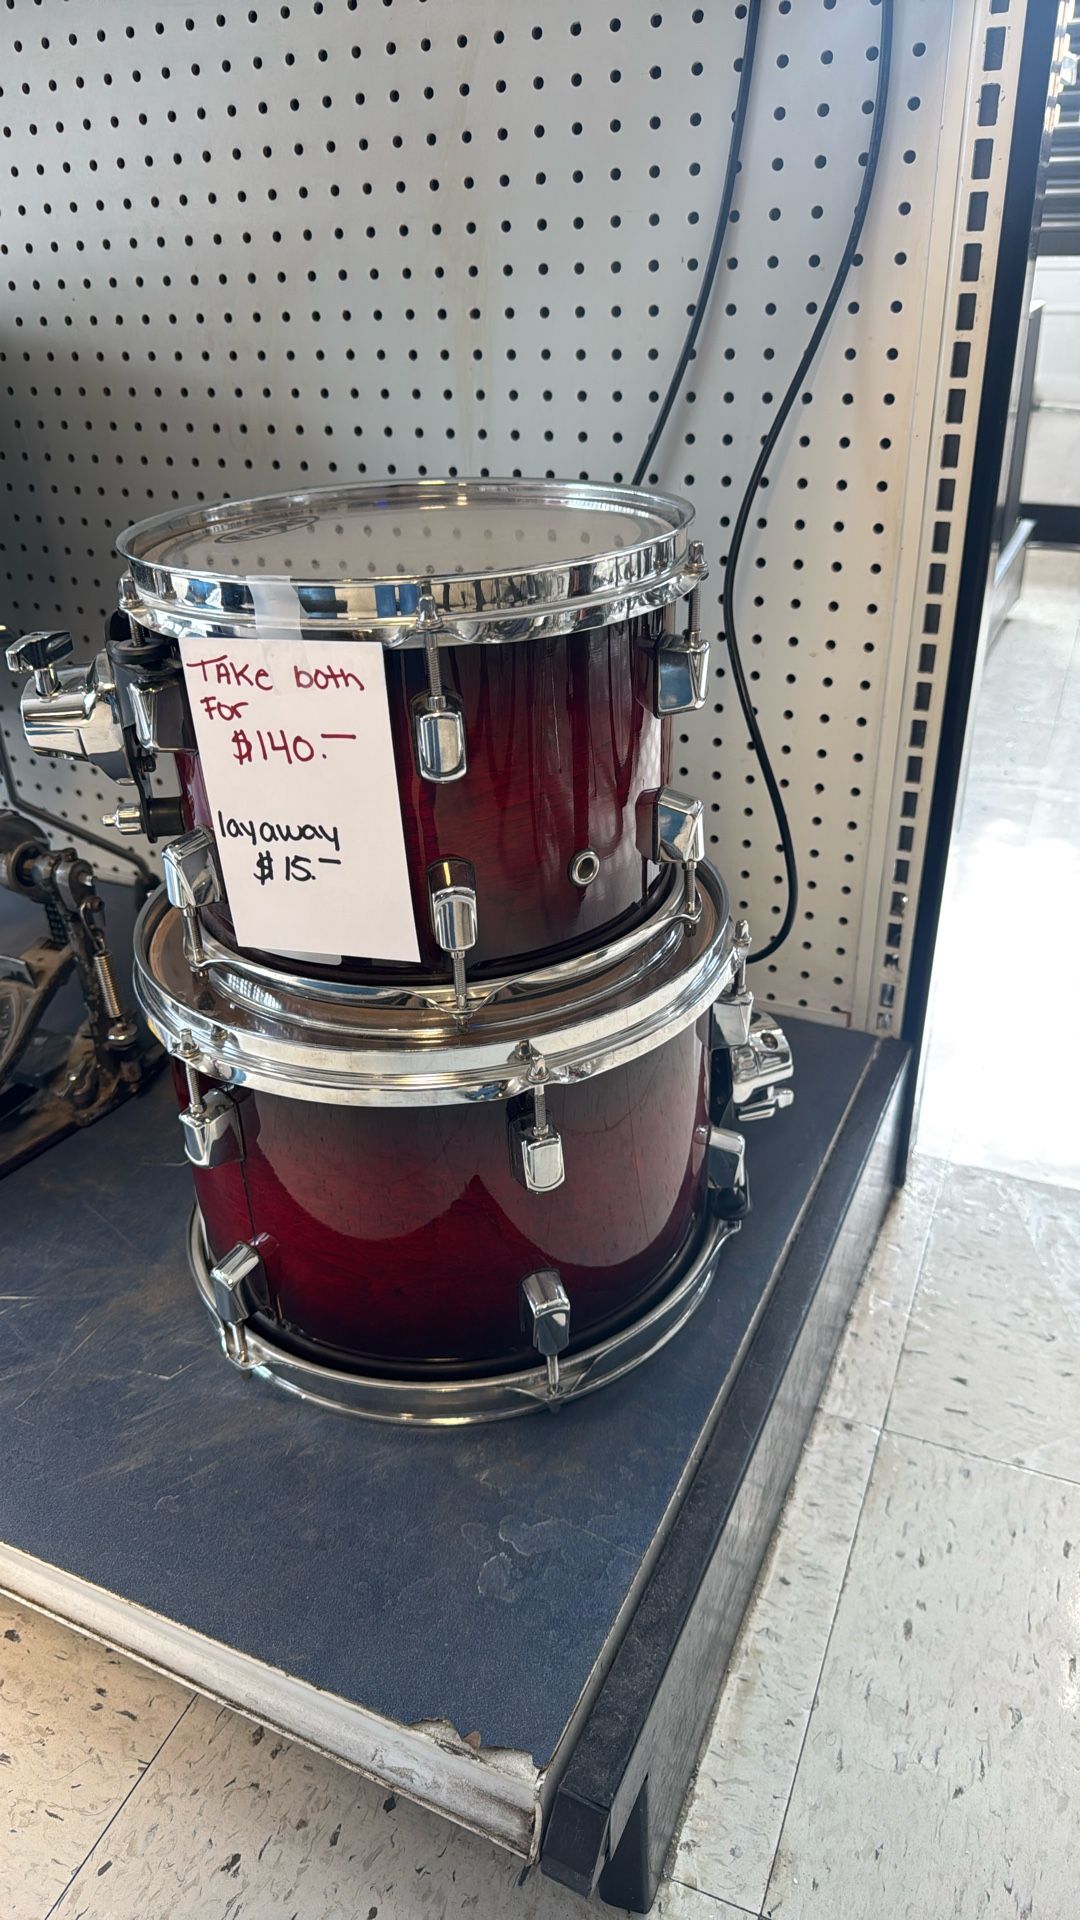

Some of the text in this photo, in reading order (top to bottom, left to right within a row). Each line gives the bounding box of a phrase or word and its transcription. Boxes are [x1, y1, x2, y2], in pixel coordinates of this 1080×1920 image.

[294, 665, 364, 691] both
[200, 696, 248, 721] For
[218, 810, 340, 851] layaway
